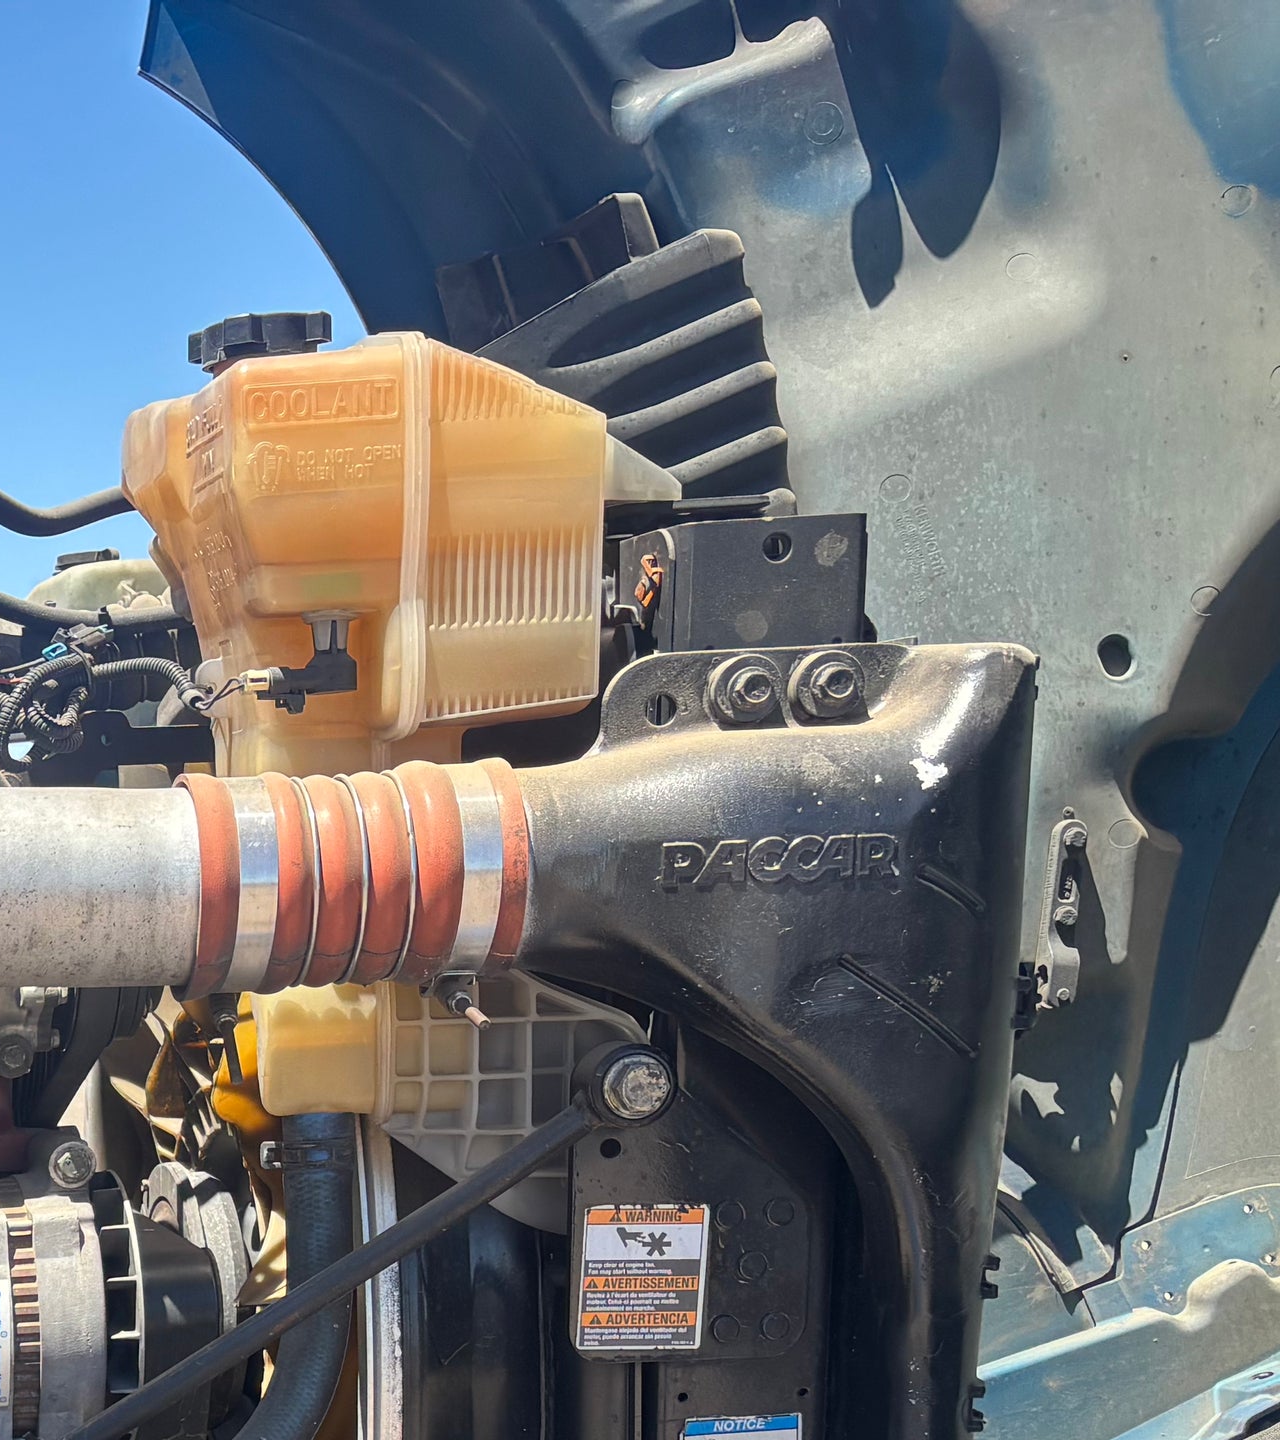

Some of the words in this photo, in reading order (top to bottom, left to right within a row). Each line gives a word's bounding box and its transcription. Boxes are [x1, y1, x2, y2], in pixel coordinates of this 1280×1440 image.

[249, 382, 392, 420] COOLANT
[296, 450, 315, 466] DO
[324, 447, 355, 464] NOT
[363, 444, 402, 461] OPEN
[296, 464, 335, 482] WHEN
[348, 463, 374, 479] HOT
[659, 832, 901, 893] PACCAR
[625, 1210, 682, 1222] WARNING
[602, 1277, 697, 1289] AVERTISSEMENT
[606, 1313, 689, 1325] ADVERTENCIA
[712, 1418, 766, 1432] NOTICE
